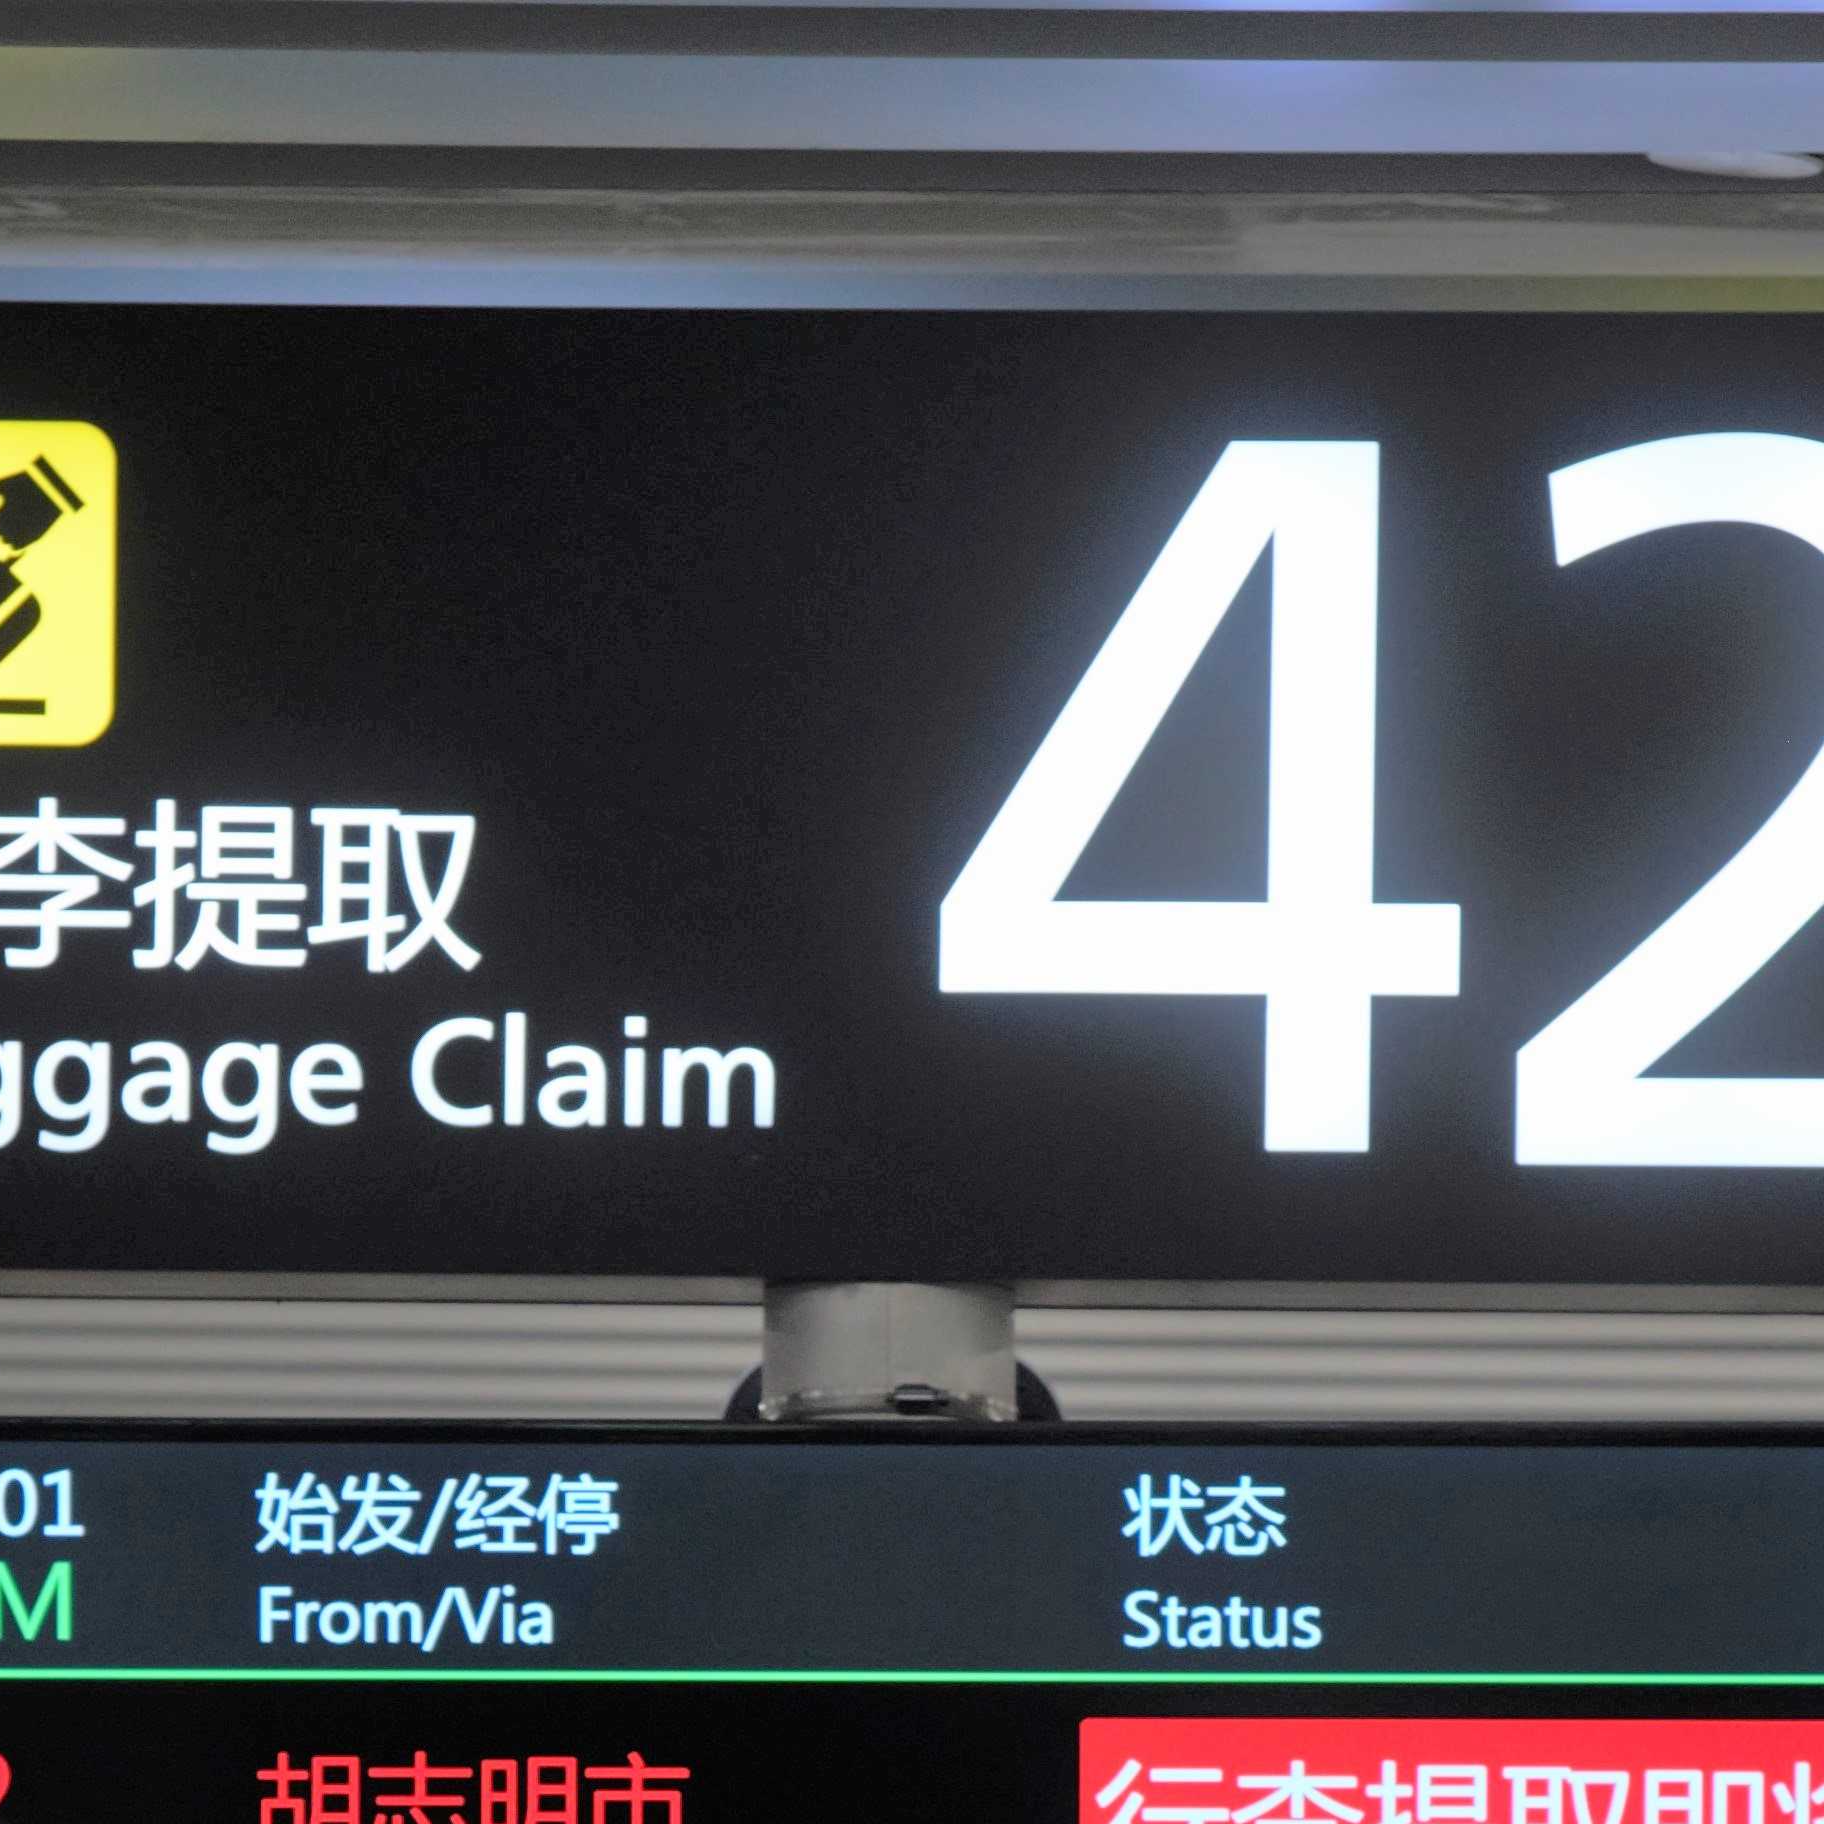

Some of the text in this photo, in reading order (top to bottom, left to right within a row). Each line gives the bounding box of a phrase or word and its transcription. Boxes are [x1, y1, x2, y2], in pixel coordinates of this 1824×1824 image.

[412, 1012, 775, 1128] Claim
[256, 1473, 619, 1554] 始发/经停
[1123, 1474, 1286, 1556] 状态
[261, 1585, 553, 1651] From/Via
[1125, 1591, 1321, 1647] Status
